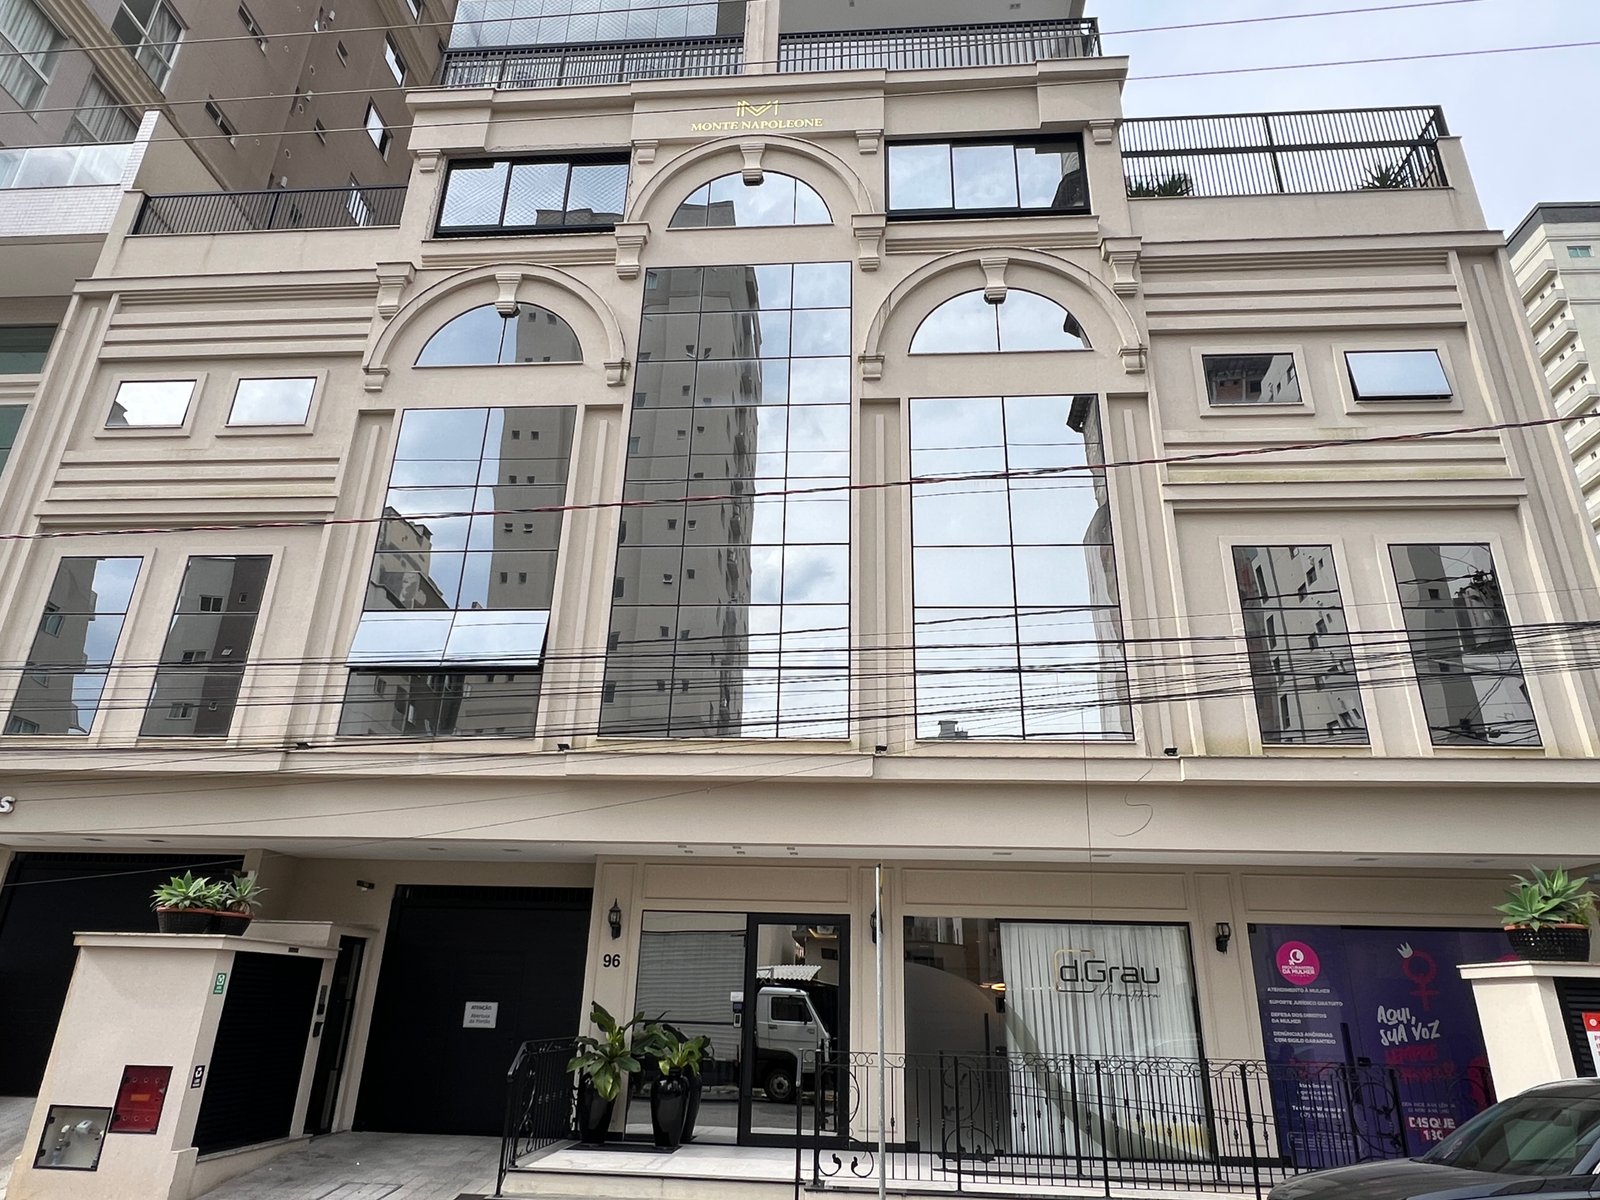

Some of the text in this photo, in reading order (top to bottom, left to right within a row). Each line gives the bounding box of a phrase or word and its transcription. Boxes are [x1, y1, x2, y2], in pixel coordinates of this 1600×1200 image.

[691, 118, 823, 132] MONTE NAPOLEONE
[603, 953, 621, 968] 96
[1060, 959, 1160, 984] d.Grau
